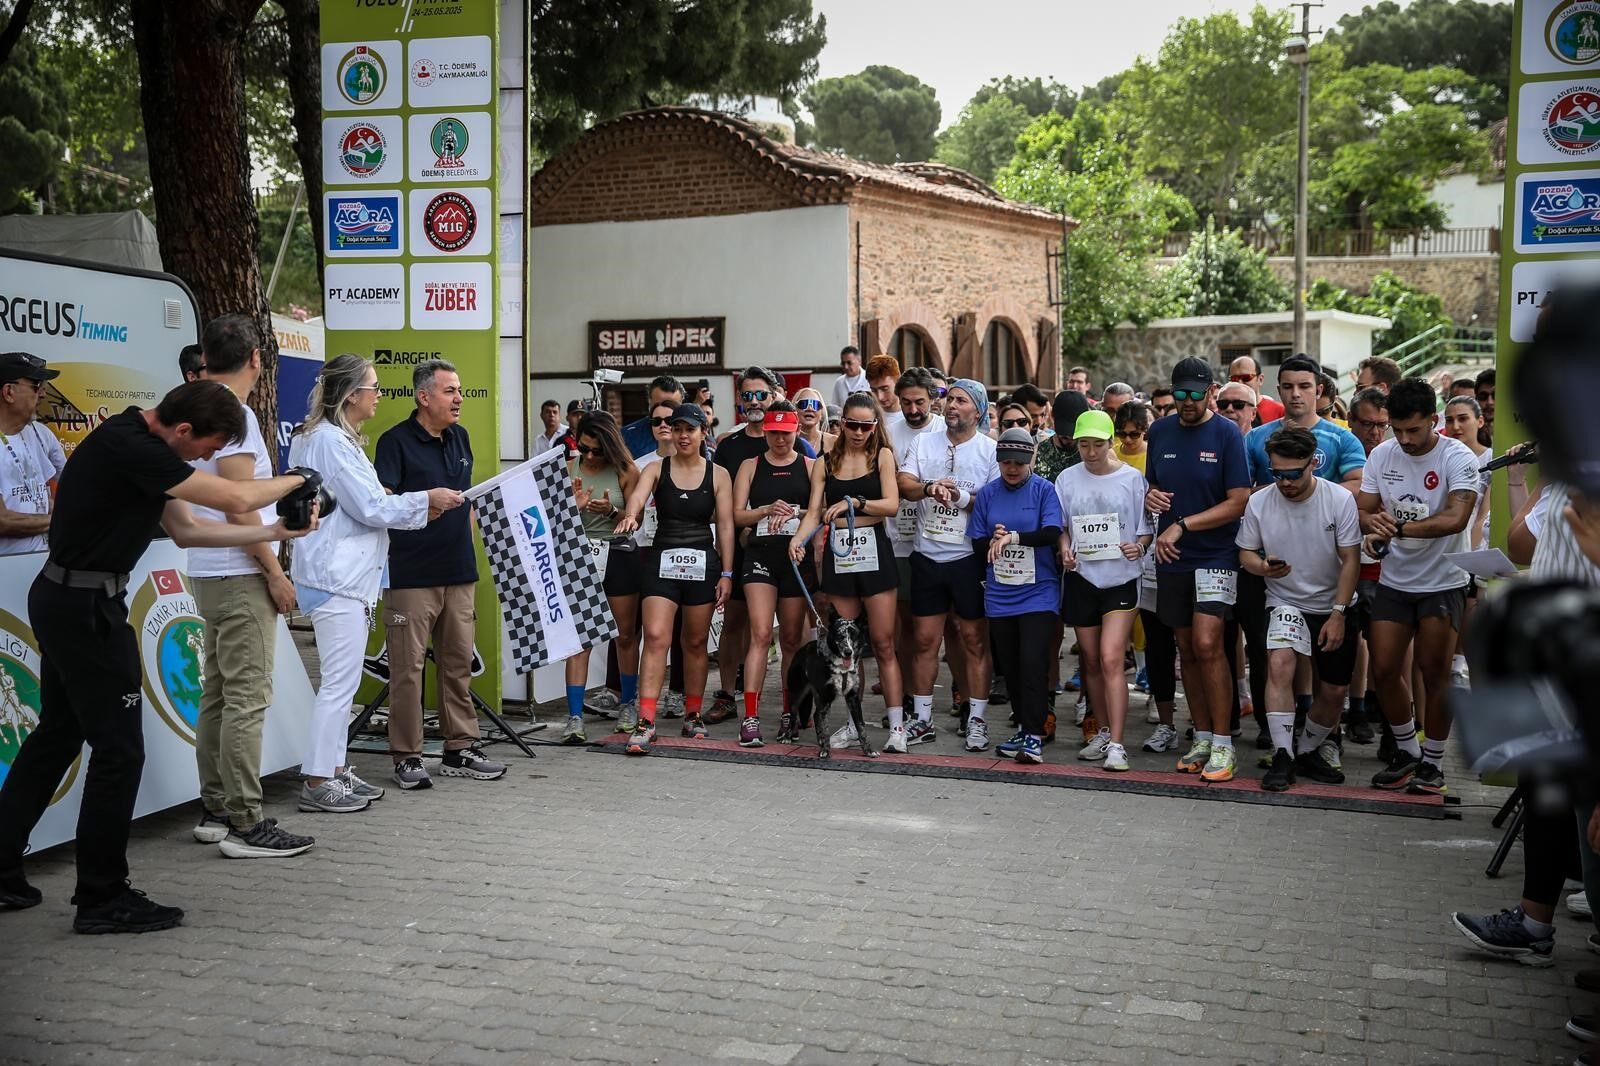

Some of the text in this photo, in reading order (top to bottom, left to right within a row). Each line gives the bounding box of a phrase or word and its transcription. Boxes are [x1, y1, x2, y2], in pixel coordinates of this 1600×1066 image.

[452, 61, 476, 70] ÖDEMİŞ
[438, 70, 488, 79] KAYMAKAMLIĞI
[1539, 185, 1573, 194] BOZDAĞ
[428, 199, 443, 217] ARAMA
[448, 196, 473, 217] KURTARMA
[1568, 226, 1592, 234] Kaynak
[429, 230, 446, 248] SEARCH
[457, 229, 473, 247] RESCUE
[329, 288, 400, 303] PT_ACADEMY
[425, 288, 477, 311] ZÜBER
[81, 322, 128, 343] TIMING
[598, 323, 716, 349] SEM İPEK
[598, 353, 626, 366] YÖRESEL
[627, 355, 634, 366] EL
[673, 353, 716, 365] DOKUMALARI
[86, 388, 156, 400] TECHNOLOGY PARTNER
[932, 504, 959, 517] 1068
[1081, 523, 1109, 533] 1079
[669, 555, 697, 565] 1059
[531, 541, 564, 624] ARGEUS
[144, 604, 172, 638] İZMİR
